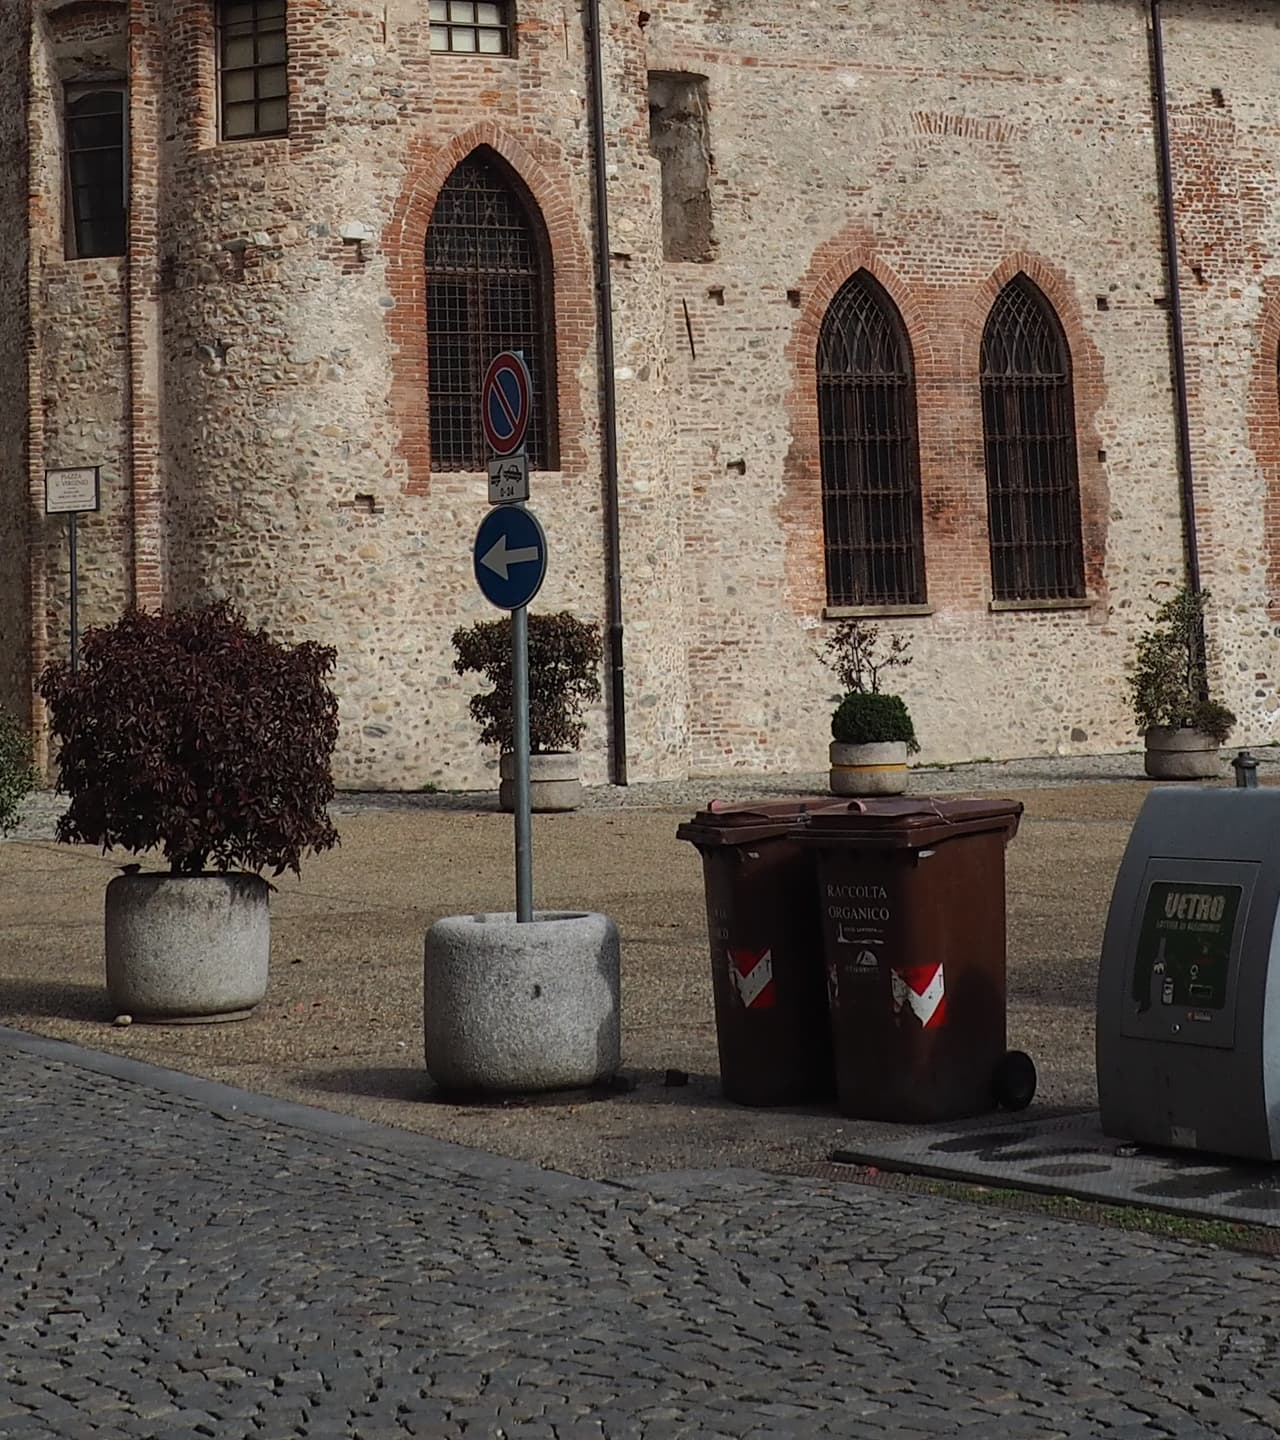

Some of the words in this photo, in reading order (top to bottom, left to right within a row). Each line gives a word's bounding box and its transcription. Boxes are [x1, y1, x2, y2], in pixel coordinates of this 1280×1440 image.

[827, 883, 888, 899] RACCOLTA
[828, 905, 890, 921] ORGANICO
[1165, 892, 1226, 922] VETRO
